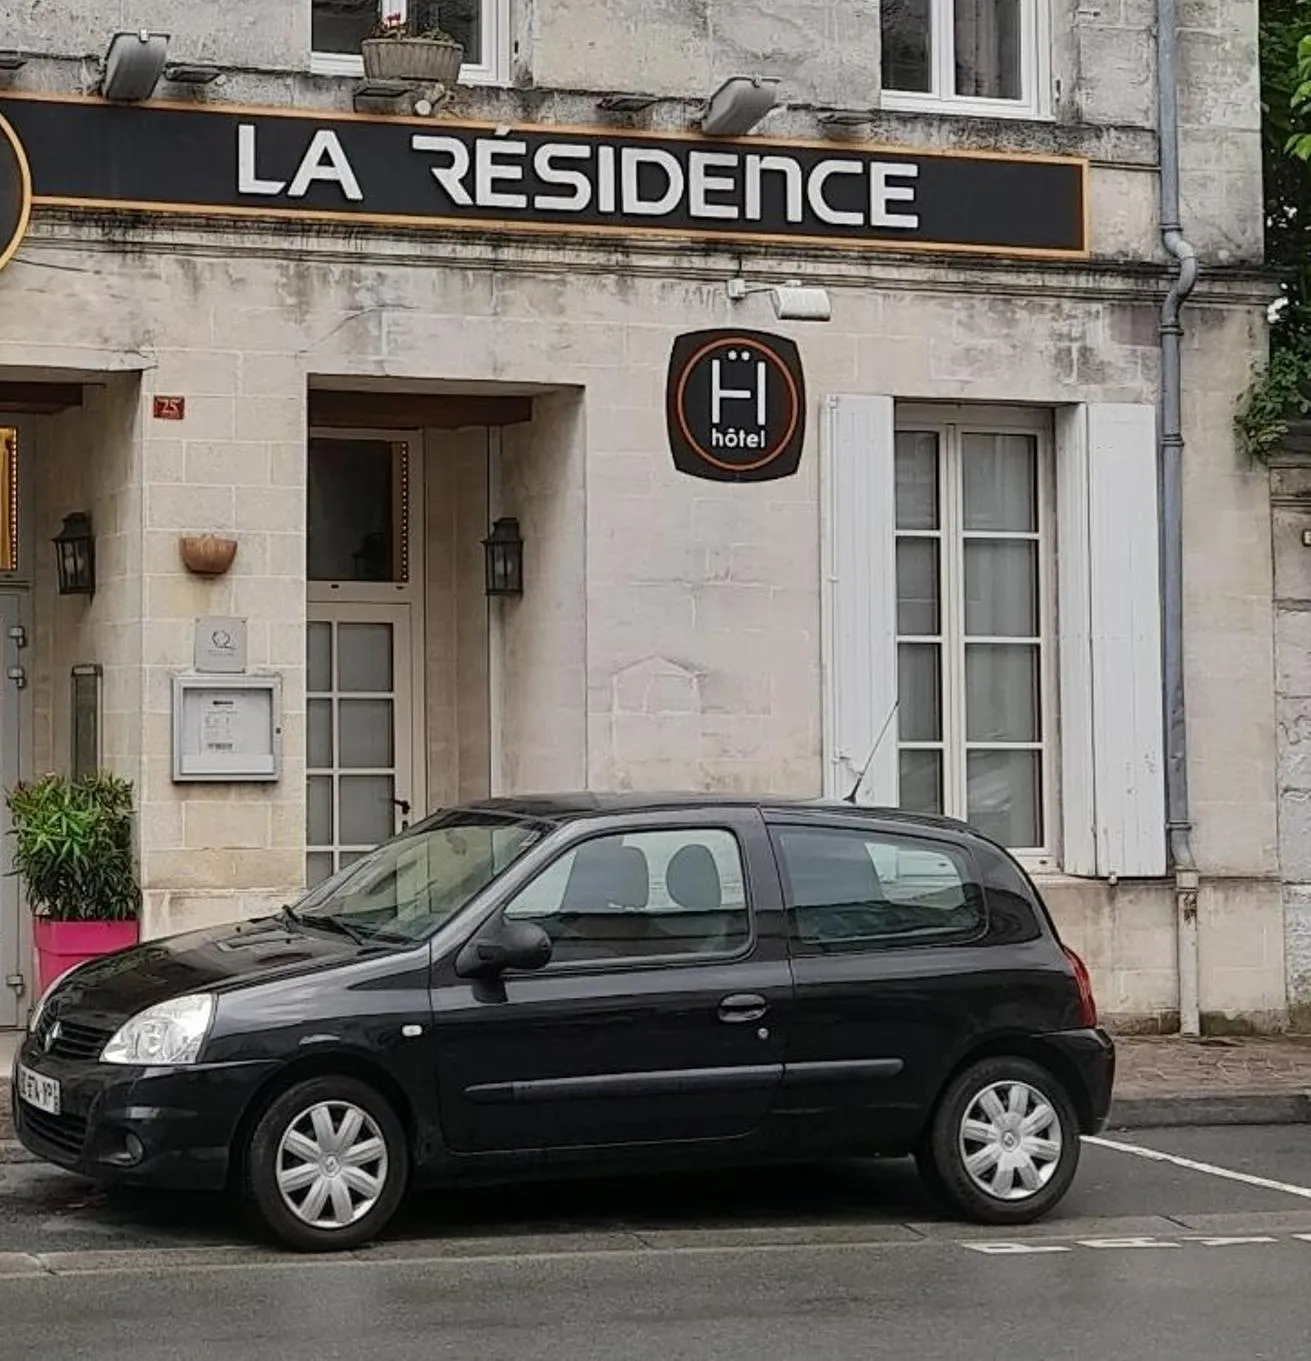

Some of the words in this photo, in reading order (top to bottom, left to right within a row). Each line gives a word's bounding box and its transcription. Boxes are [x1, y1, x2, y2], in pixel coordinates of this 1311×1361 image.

[238, 124, 363, 200] LA
[711, 359, 766, 425] H
[711, 428, 765, 448] hôtel
